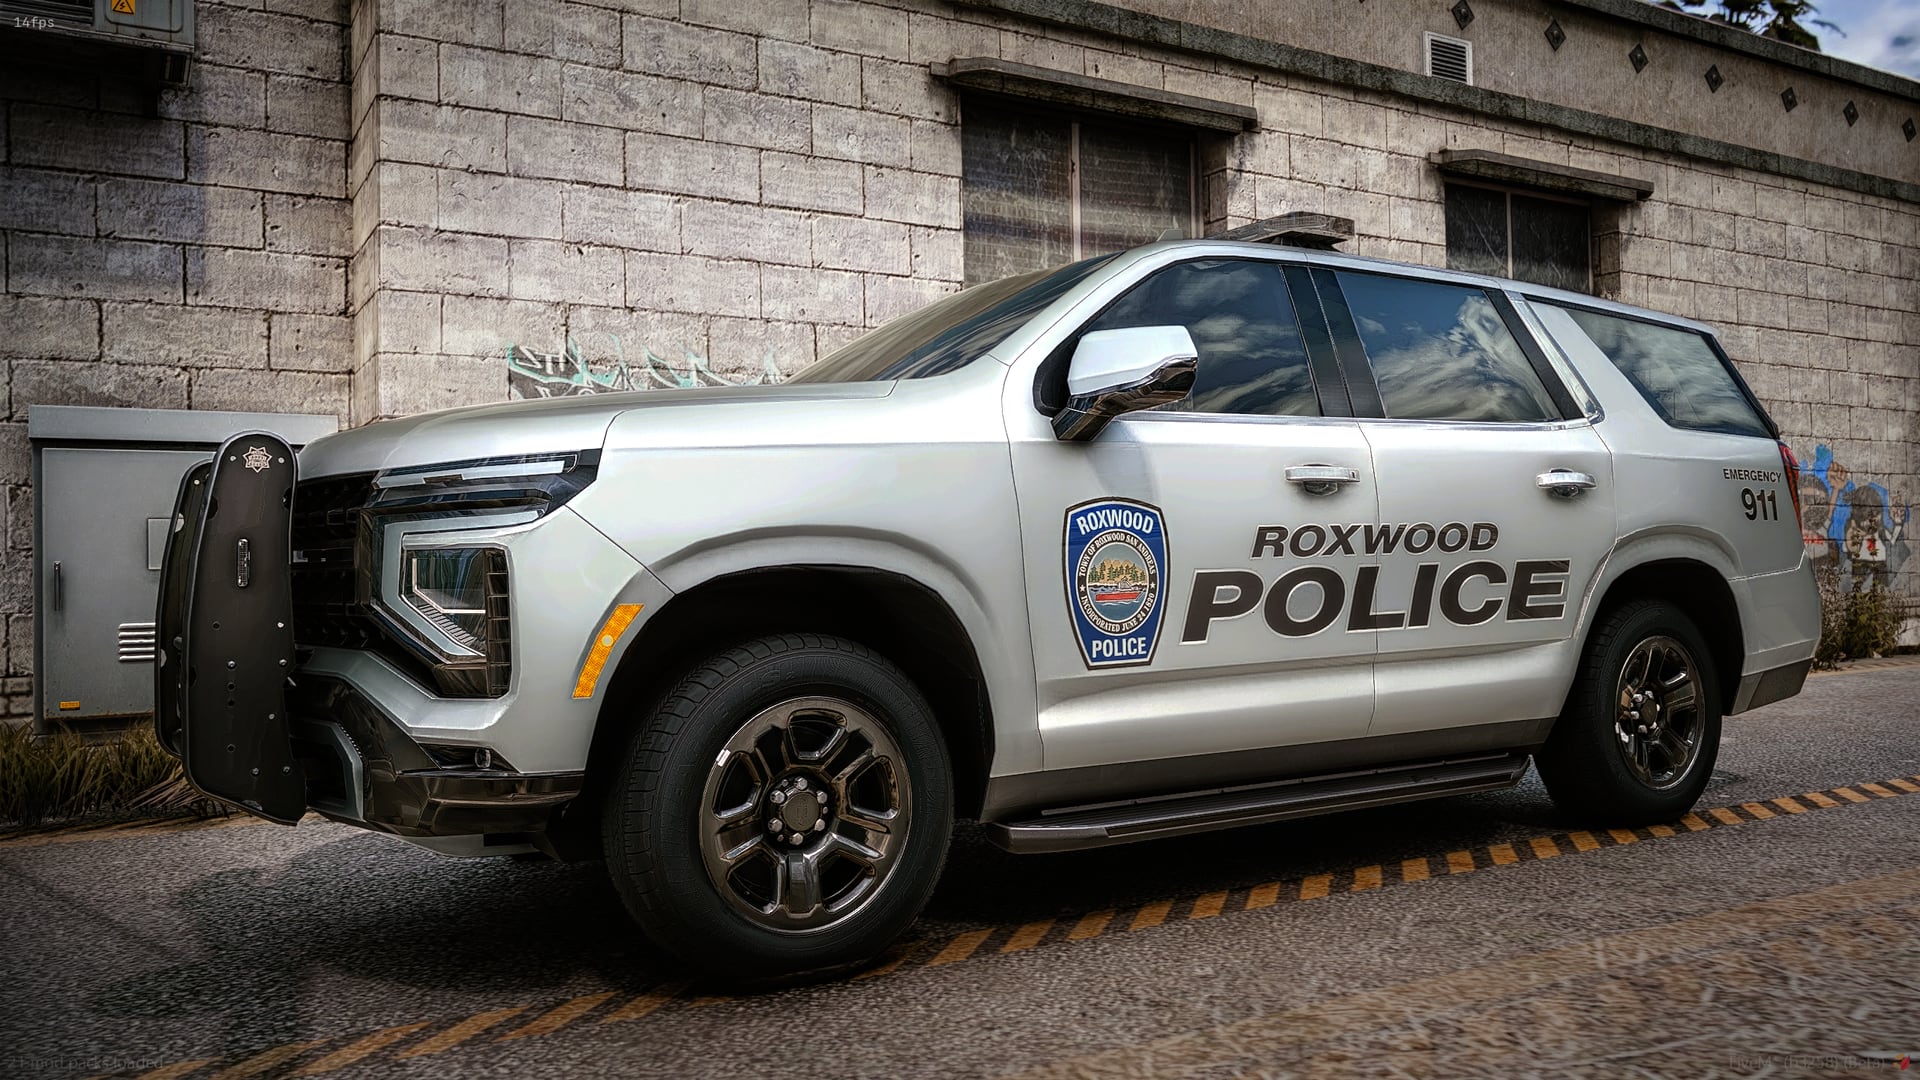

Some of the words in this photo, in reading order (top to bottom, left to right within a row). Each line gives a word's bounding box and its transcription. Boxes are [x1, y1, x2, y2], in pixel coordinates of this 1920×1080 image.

[1723, 468, 1782, 483] EMERGENCY
[1741, 487, 1778, 521] 911
[1076, 509, 1154, 535] ROXWOOD
[1079, 554, 1090, 577] TOWN
[1088, 543, 1097, 555] OF
[1095, 532, 1126, 548] ROXWOOD
[1125, 533, 1138, 546] SAN
[1136, 543, 1156, 575] ANDREAS
[1250, 521, 1500, 560] ROXWOOD
[1080, 595, 1121, 632] INCORPORATED
[1121, 618, 1139, 631] JUNE
[1179, 559, 1572, 645] POLICE
[1091, 637, 1147, 658] POLICE
